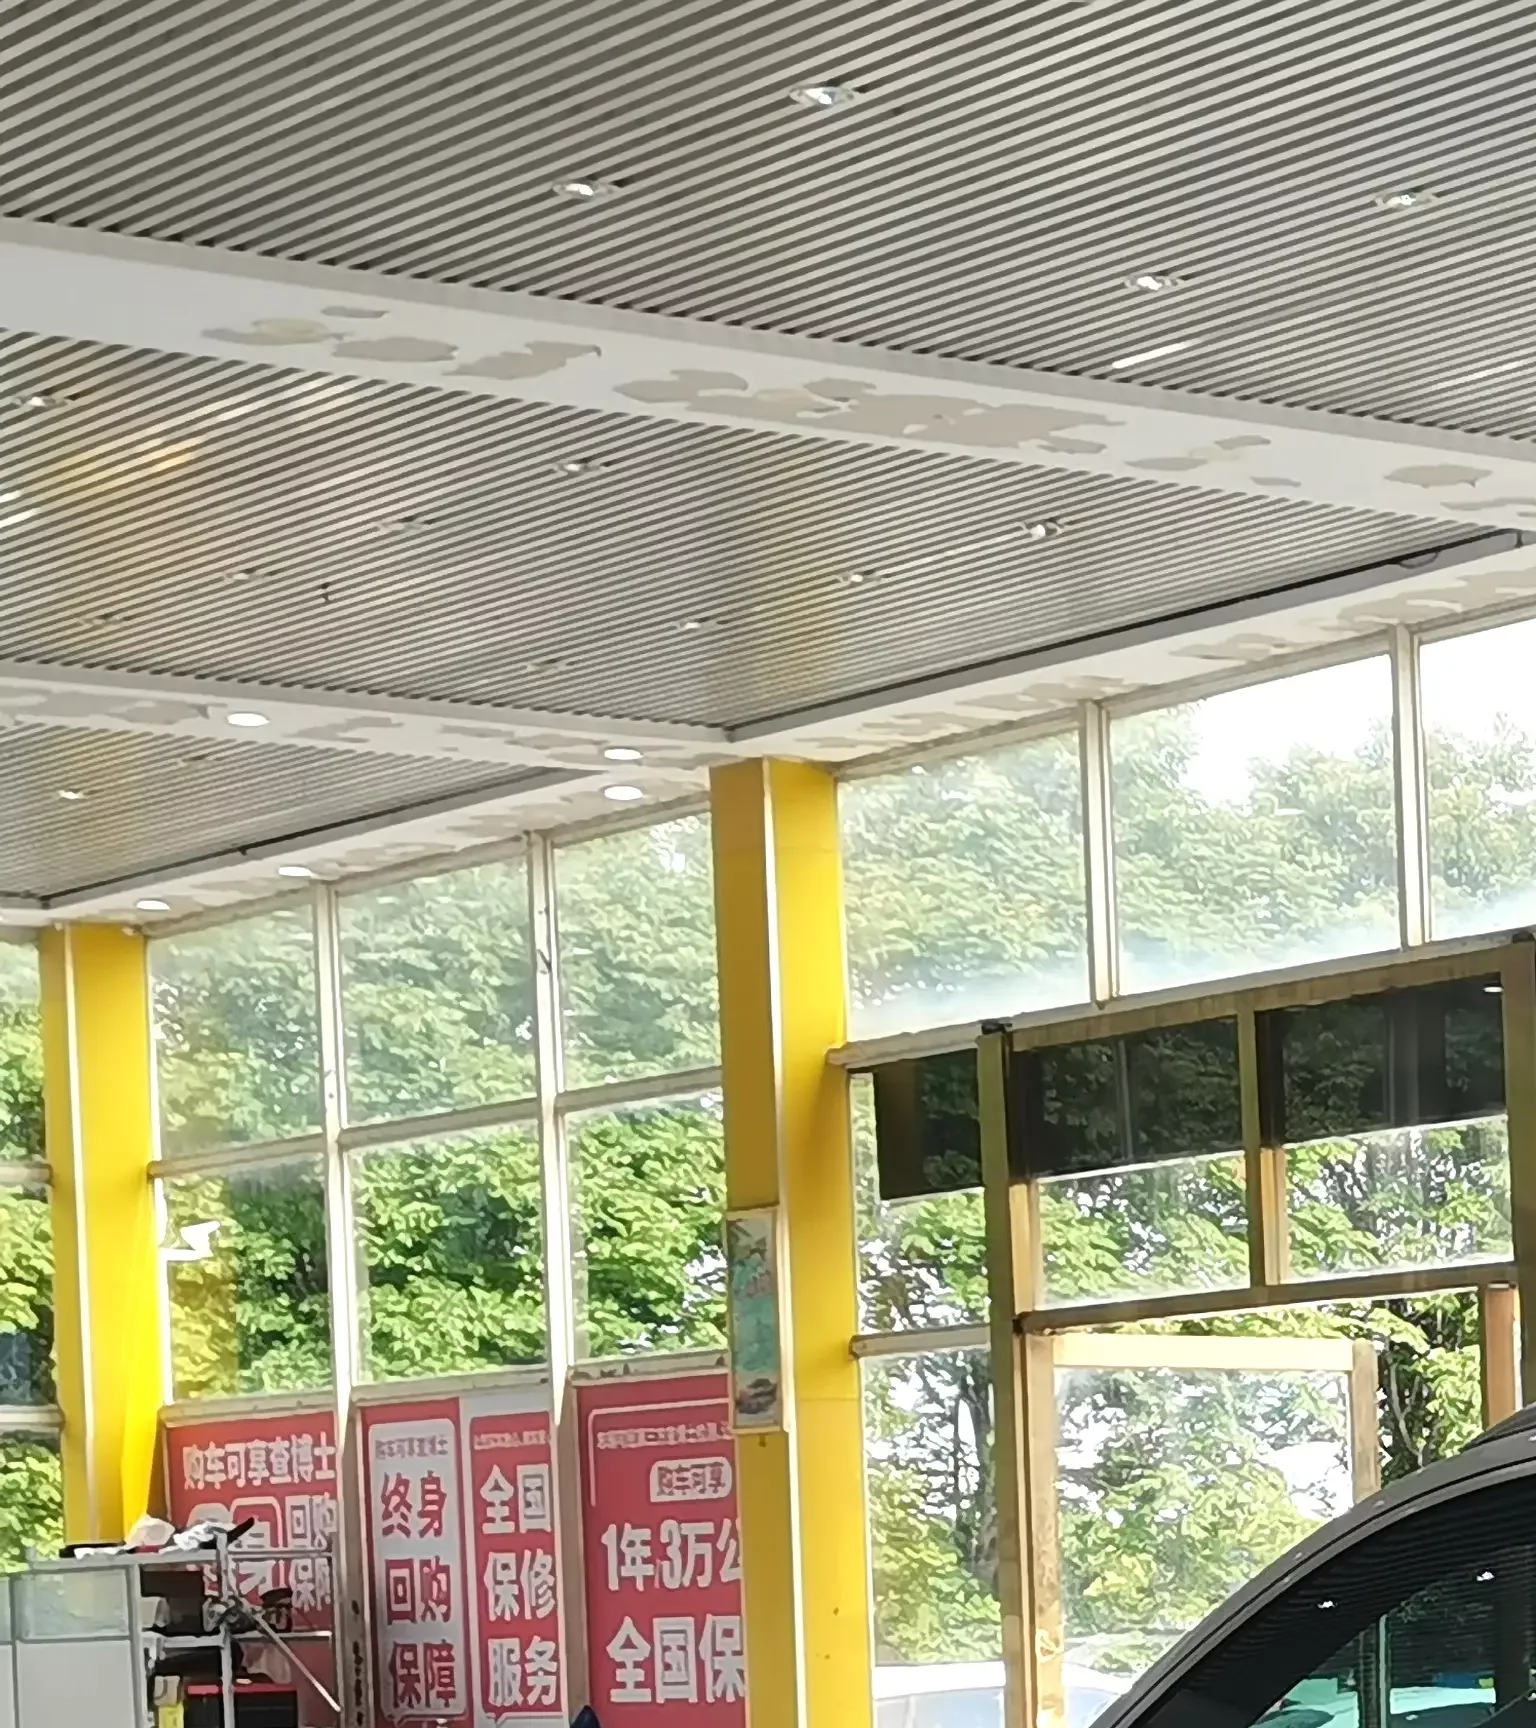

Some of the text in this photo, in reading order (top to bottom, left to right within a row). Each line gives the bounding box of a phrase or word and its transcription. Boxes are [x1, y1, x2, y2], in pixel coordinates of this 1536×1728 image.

[183, 1432, 336, 1490] 购车可享查博士
[381, 1470, 448, 1538] 终身
[480, 1464, 551, 1534] 全国
[385, 1555, 450, 1626] 回购
[484, 1549, 555, 1621] 保修
[388, 1638, 456, 1709] 保障
[487, 1635, 557, 1706] 服务
